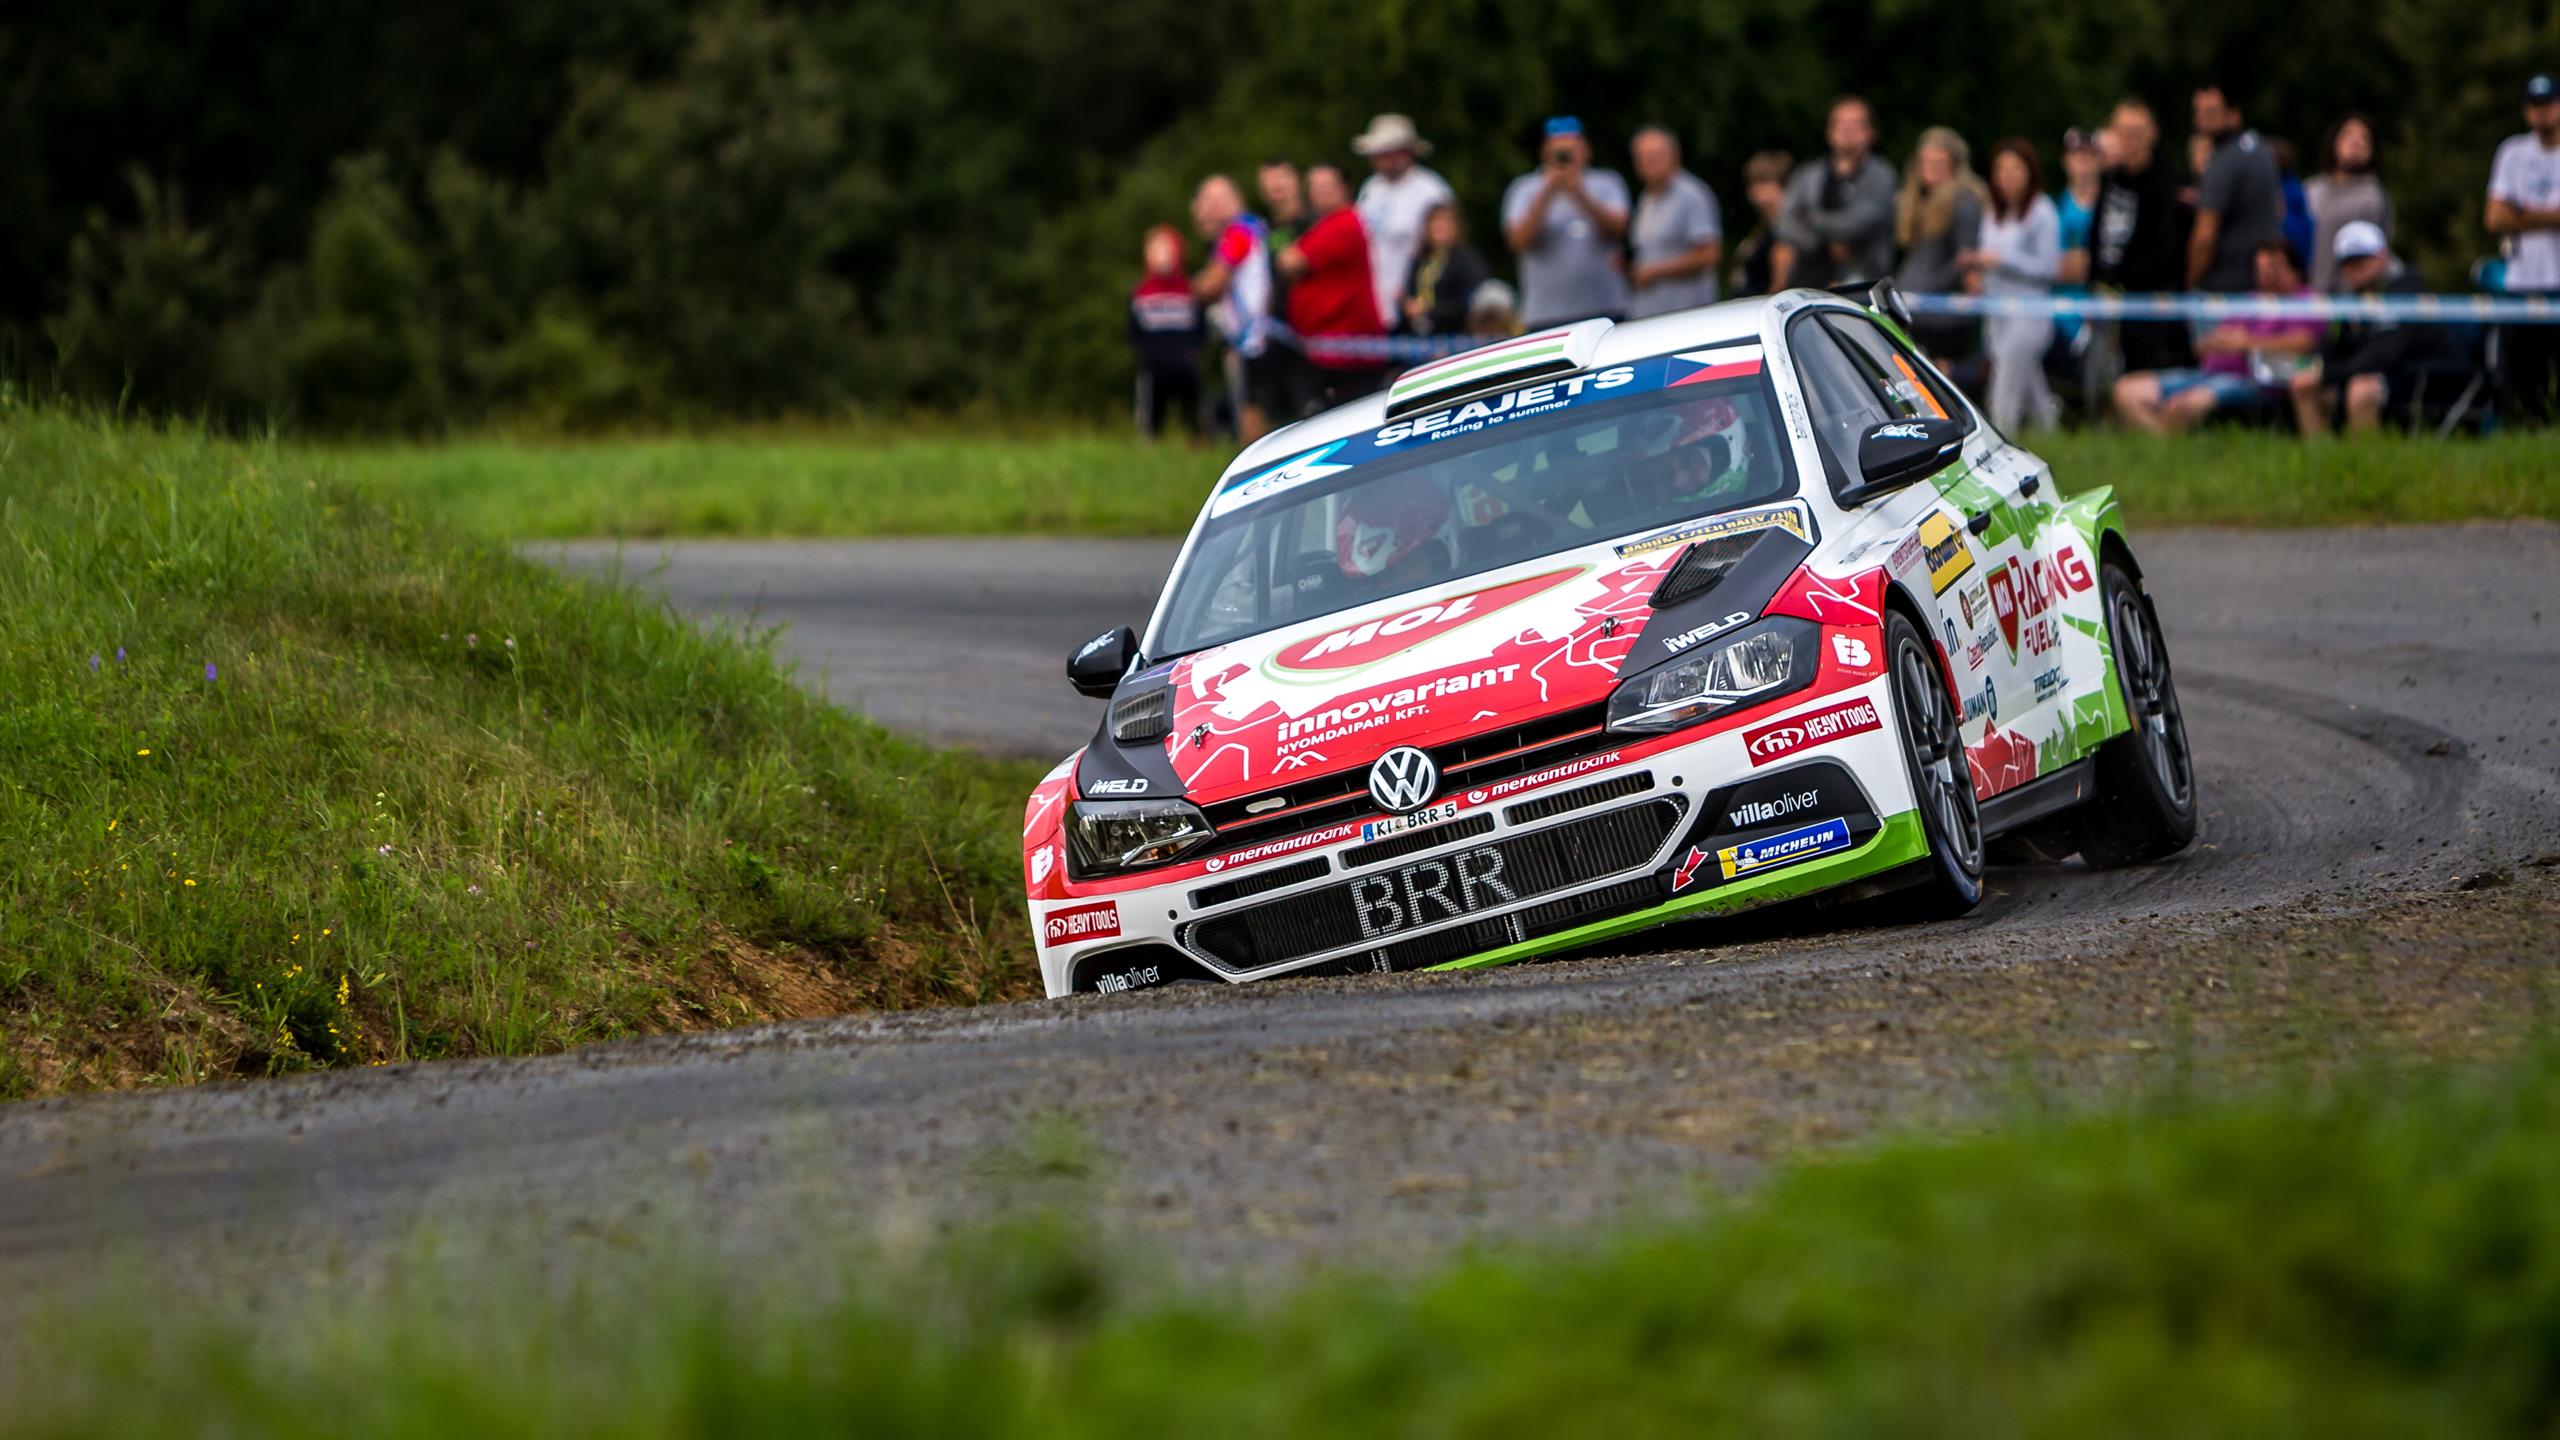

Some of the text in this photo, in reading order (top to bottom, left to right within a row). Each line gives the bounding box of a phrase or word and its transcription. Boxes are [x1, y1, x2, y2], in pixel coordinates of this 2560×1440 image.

[1374, 366, 1634, 447] SEAJETS
[1431, 399, 1571, 441] Racing to summer
[2008, 545, 2094, 621] RACING
[1300, 593, 1479, 662] MOL
[1662, 610, 1751, 653] iWELD
[1276, 704, 1430, 757] NYOMDAIPARI KFT.
[1088, 778, 1149, 795] iWELD
[1491, 751, 1621, 796] merkantilbank
[1376, 803, 1456, 837] KI BRR 5
[1729, 788, 1820, 828] villaoliver
[1228, 823, 1355, 865] merkantilbank
[1758, 830, 1834, 860] MICHELIN
[1350, 846, 1517, 939] BRR
[1095, 964, 1161, 995] villaoliver
